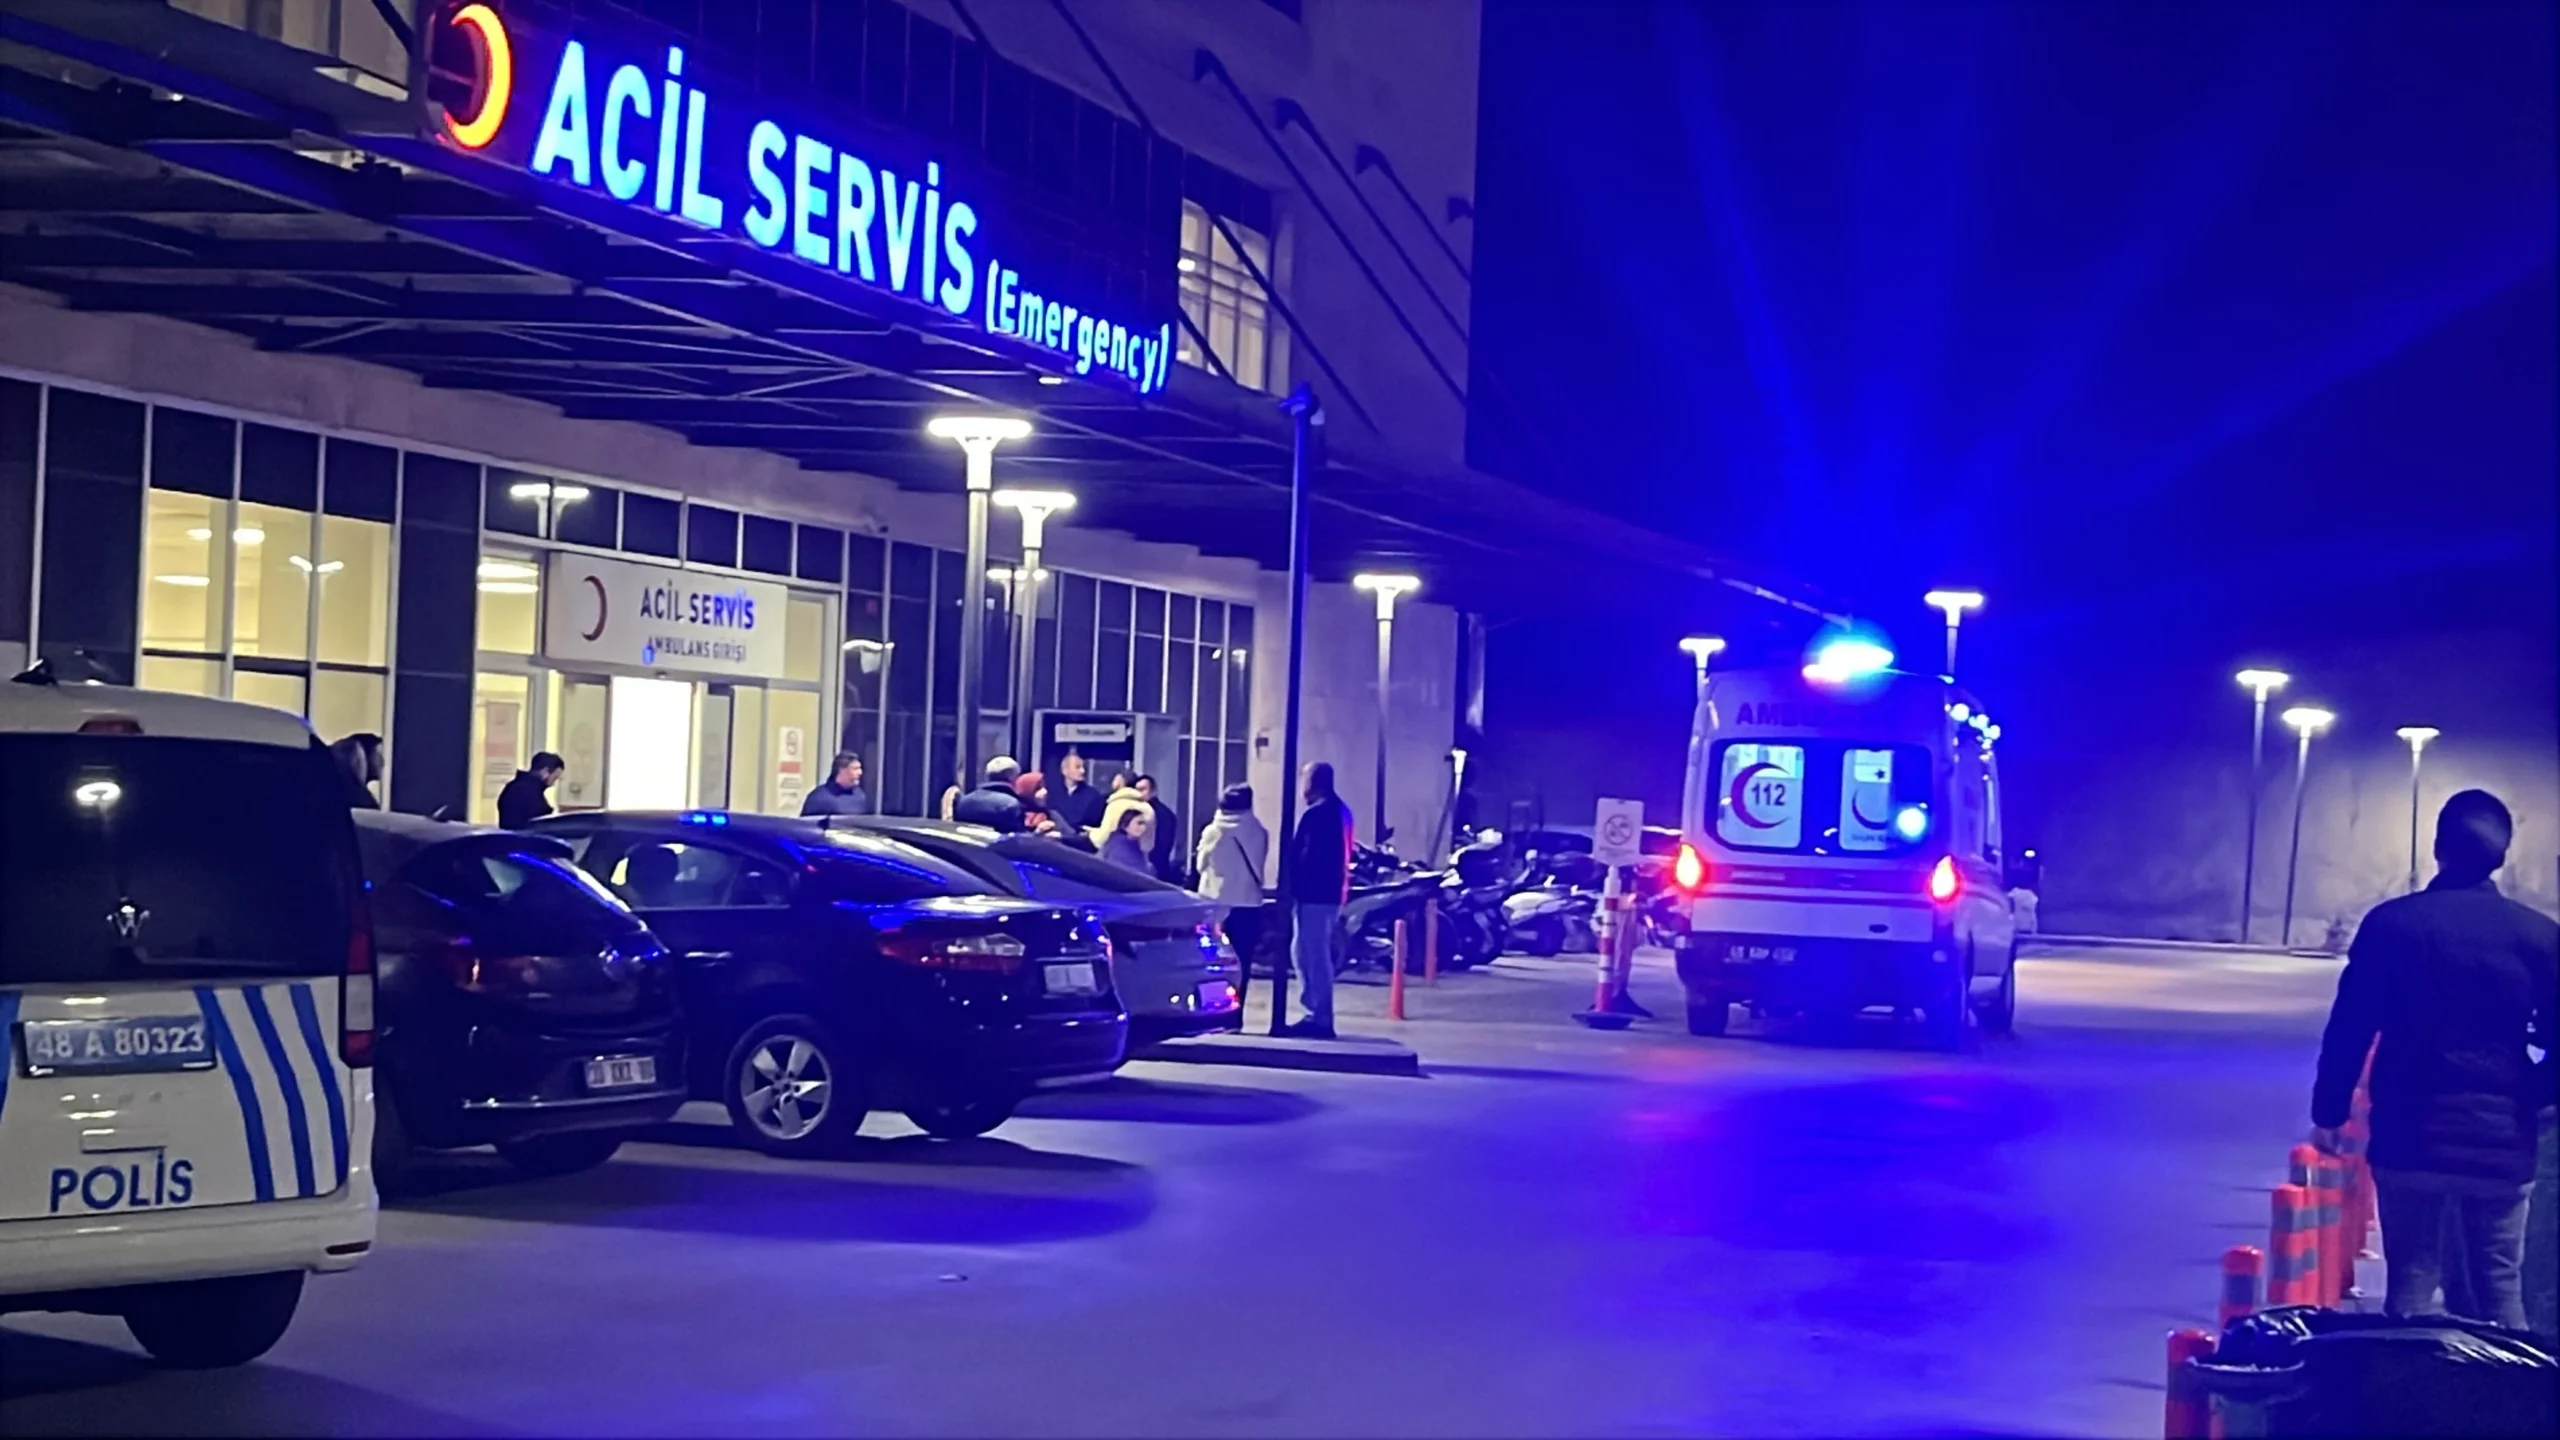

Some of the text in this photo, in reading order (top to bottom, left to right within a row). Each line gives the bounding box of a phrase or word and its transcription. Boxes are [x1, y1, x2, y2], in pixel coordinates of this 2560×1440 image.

[531, 40, 1170, 394] ACİL SERVİS (Emergency)
[640, 578, 755, 630] ACİL SERVİS
[1750, 783, 1787, 807] 112
[36, 1024, 205, 1058] 48 A 80323
[50, 1153, 195, 1213] POLİS
